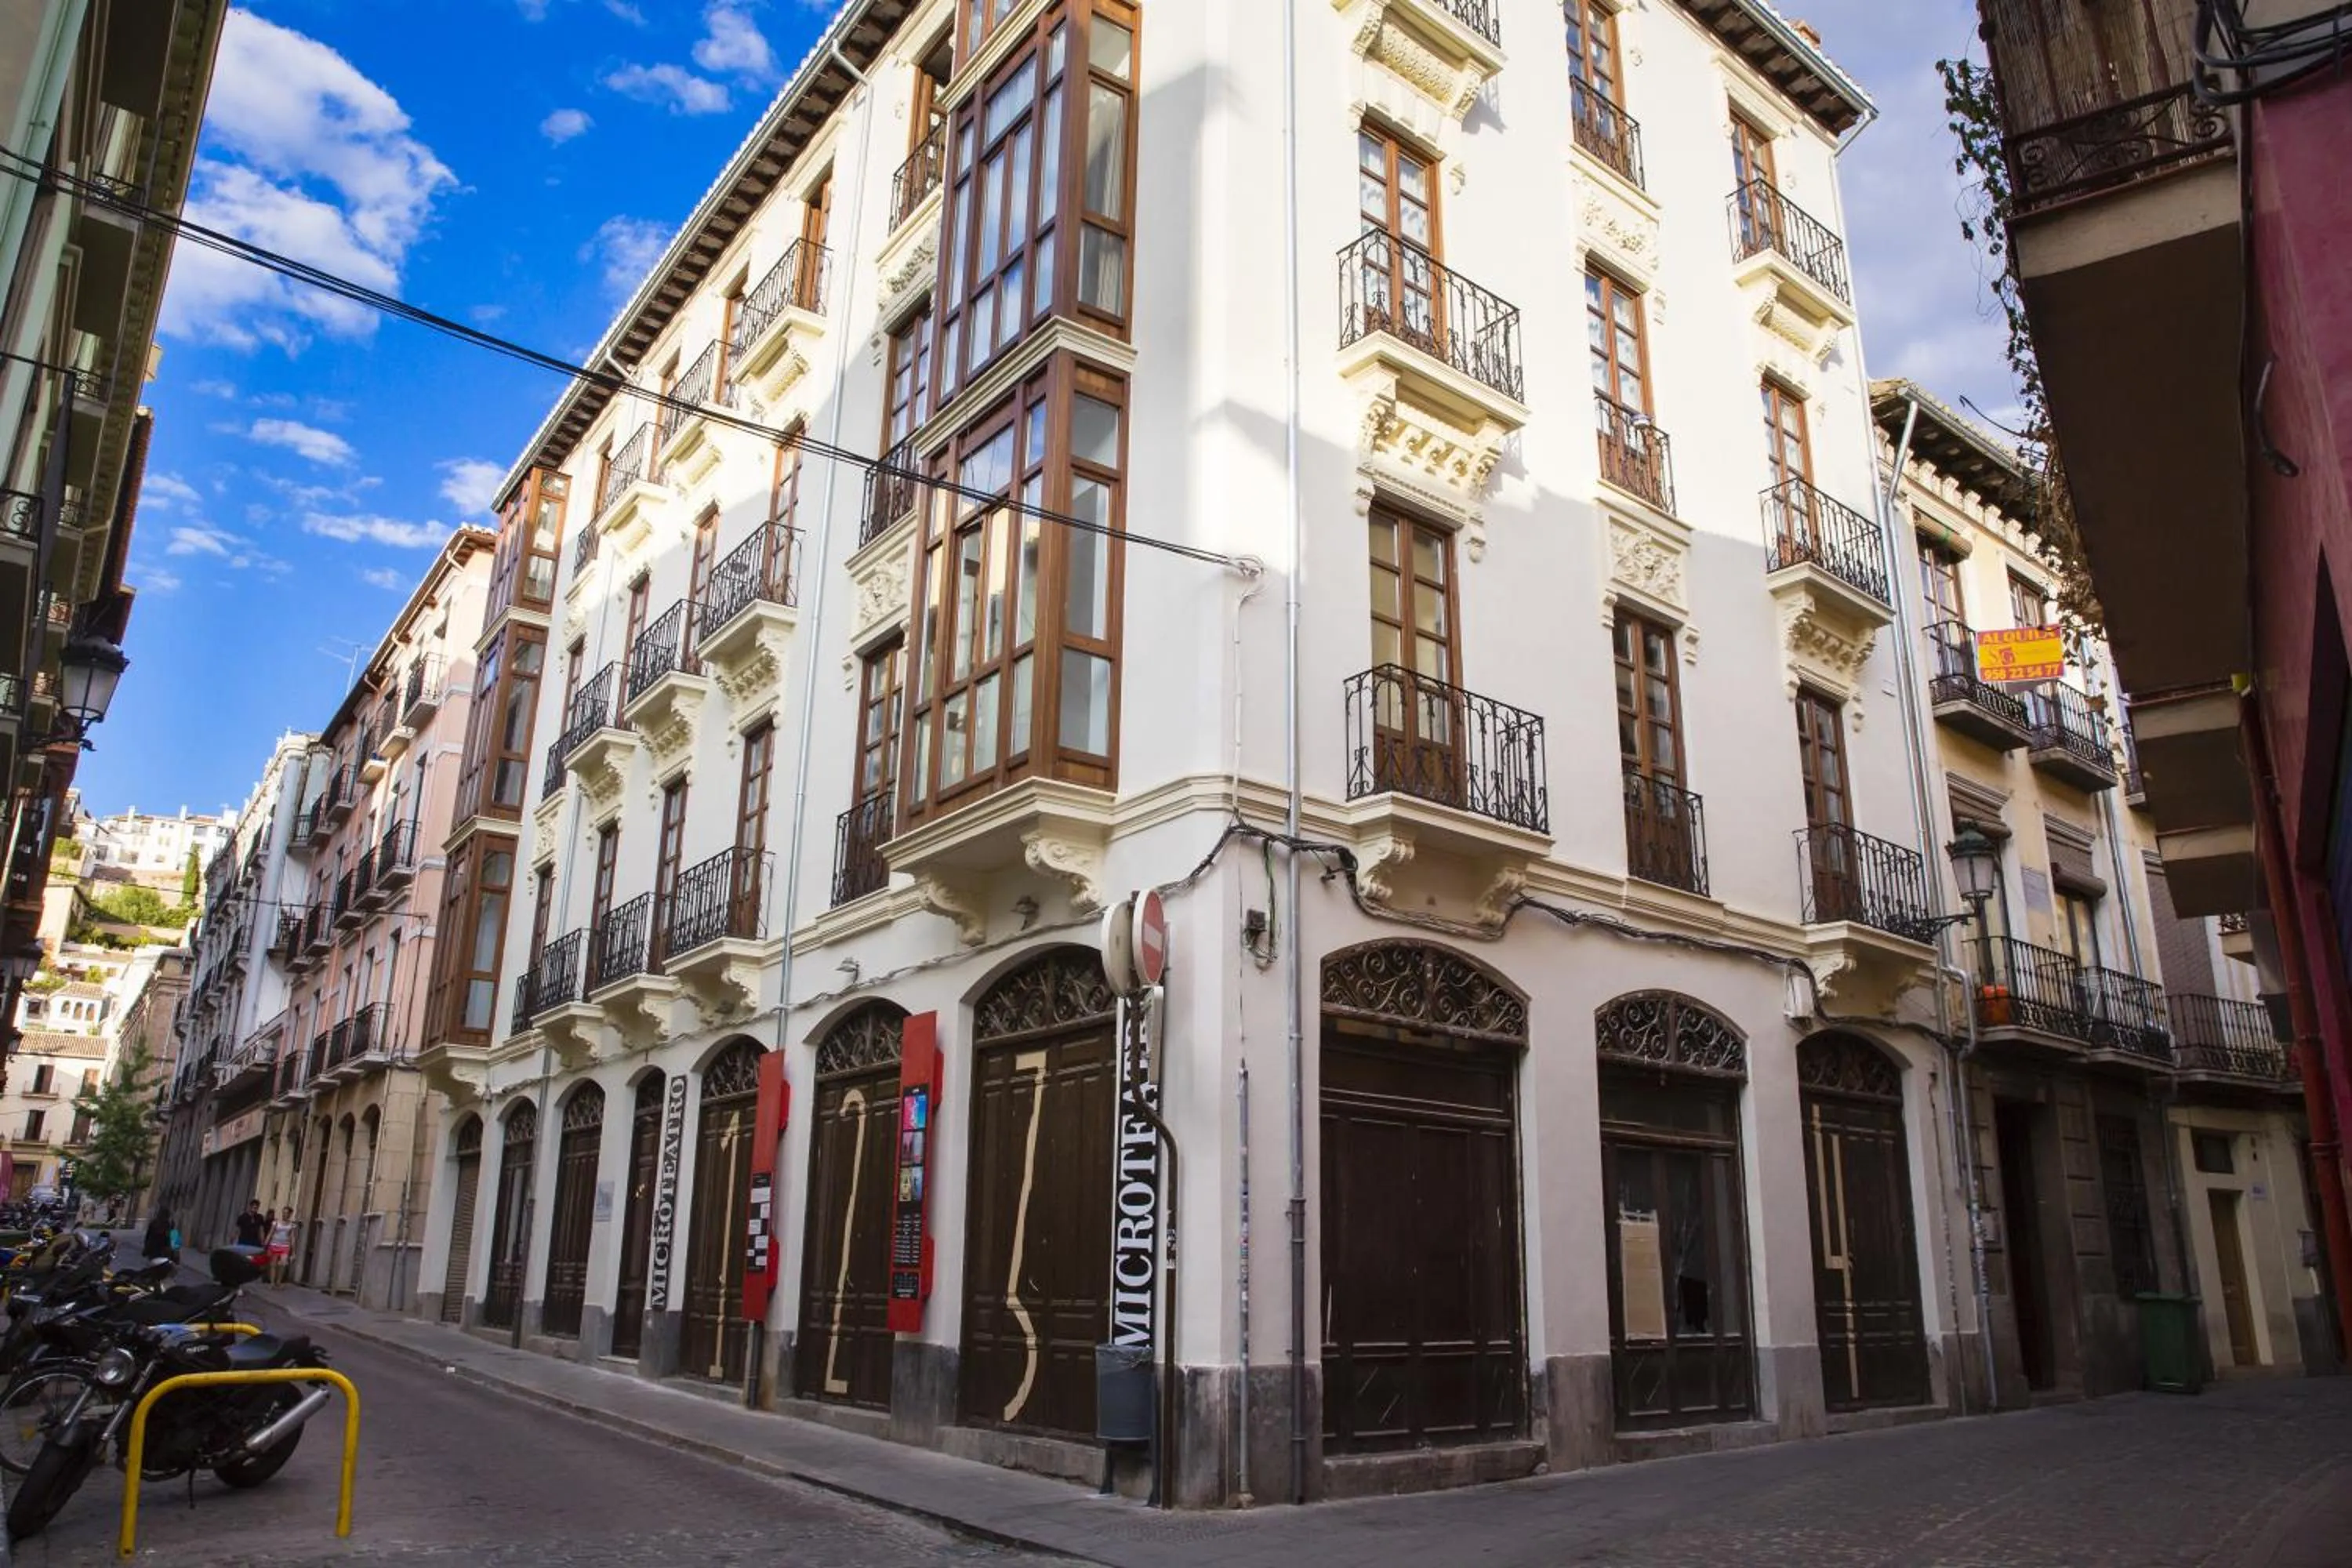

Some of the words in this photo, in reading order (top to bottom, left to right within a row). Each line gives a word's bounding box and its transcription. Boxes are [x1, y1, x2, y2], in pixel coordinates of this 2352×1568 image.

[2009, 667, 2024, 678] 22
[2045, 664, 2059, 675] 77
[652, 1078, 684, 1305] MICROTEATRO
